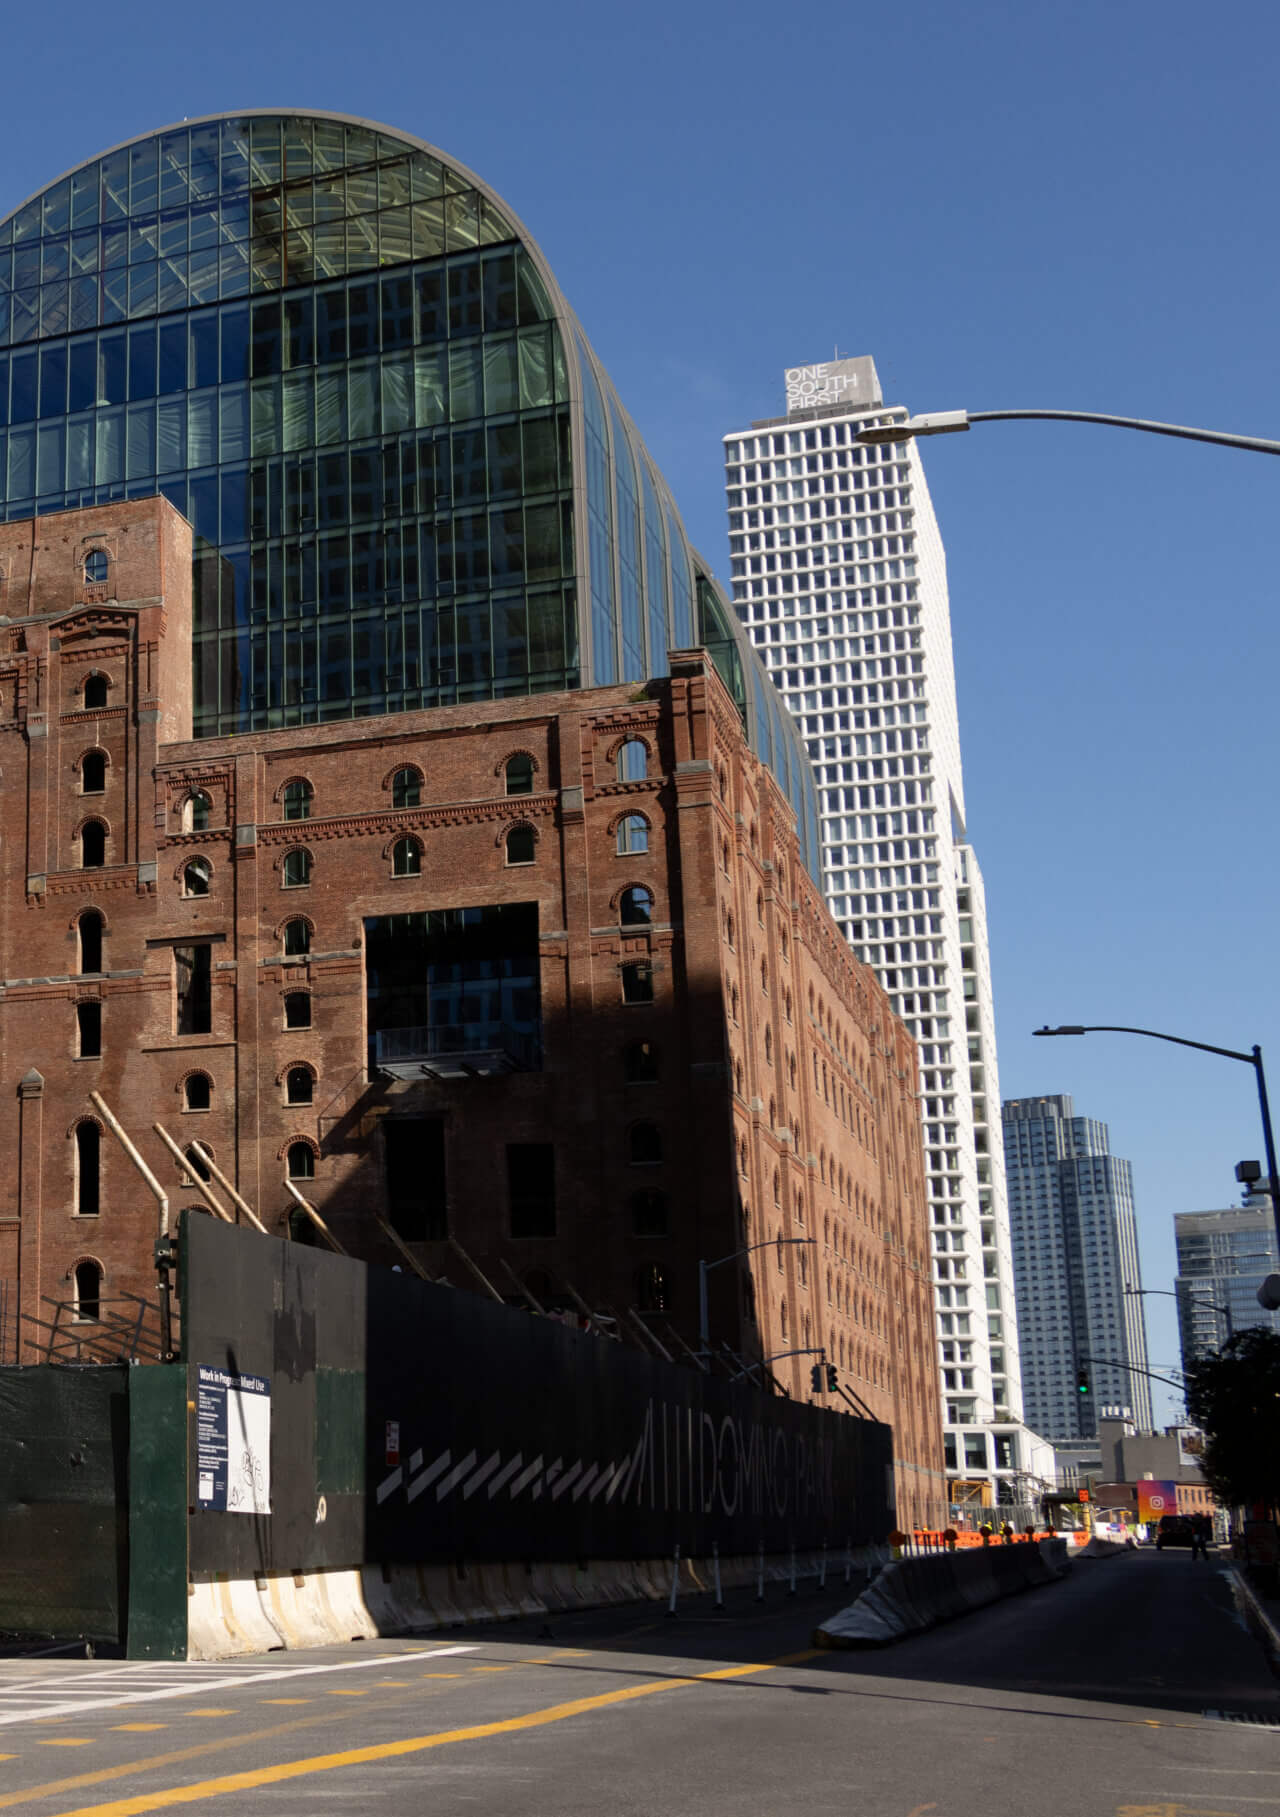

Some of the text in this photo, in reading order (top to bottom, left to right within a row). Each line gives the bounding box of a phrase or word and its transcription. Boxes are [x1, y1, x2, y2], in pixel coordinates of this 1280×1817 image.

[786, 363, 829, 384] ONE
[786, 372, 857, 398] SOUTH
[789, 390, 844, 410] FIRST
[200, 1368, 214, 1382] Work
[255, 1378, 265, 1392] Use
[700, 1411, 789, 1518] DOMINO
